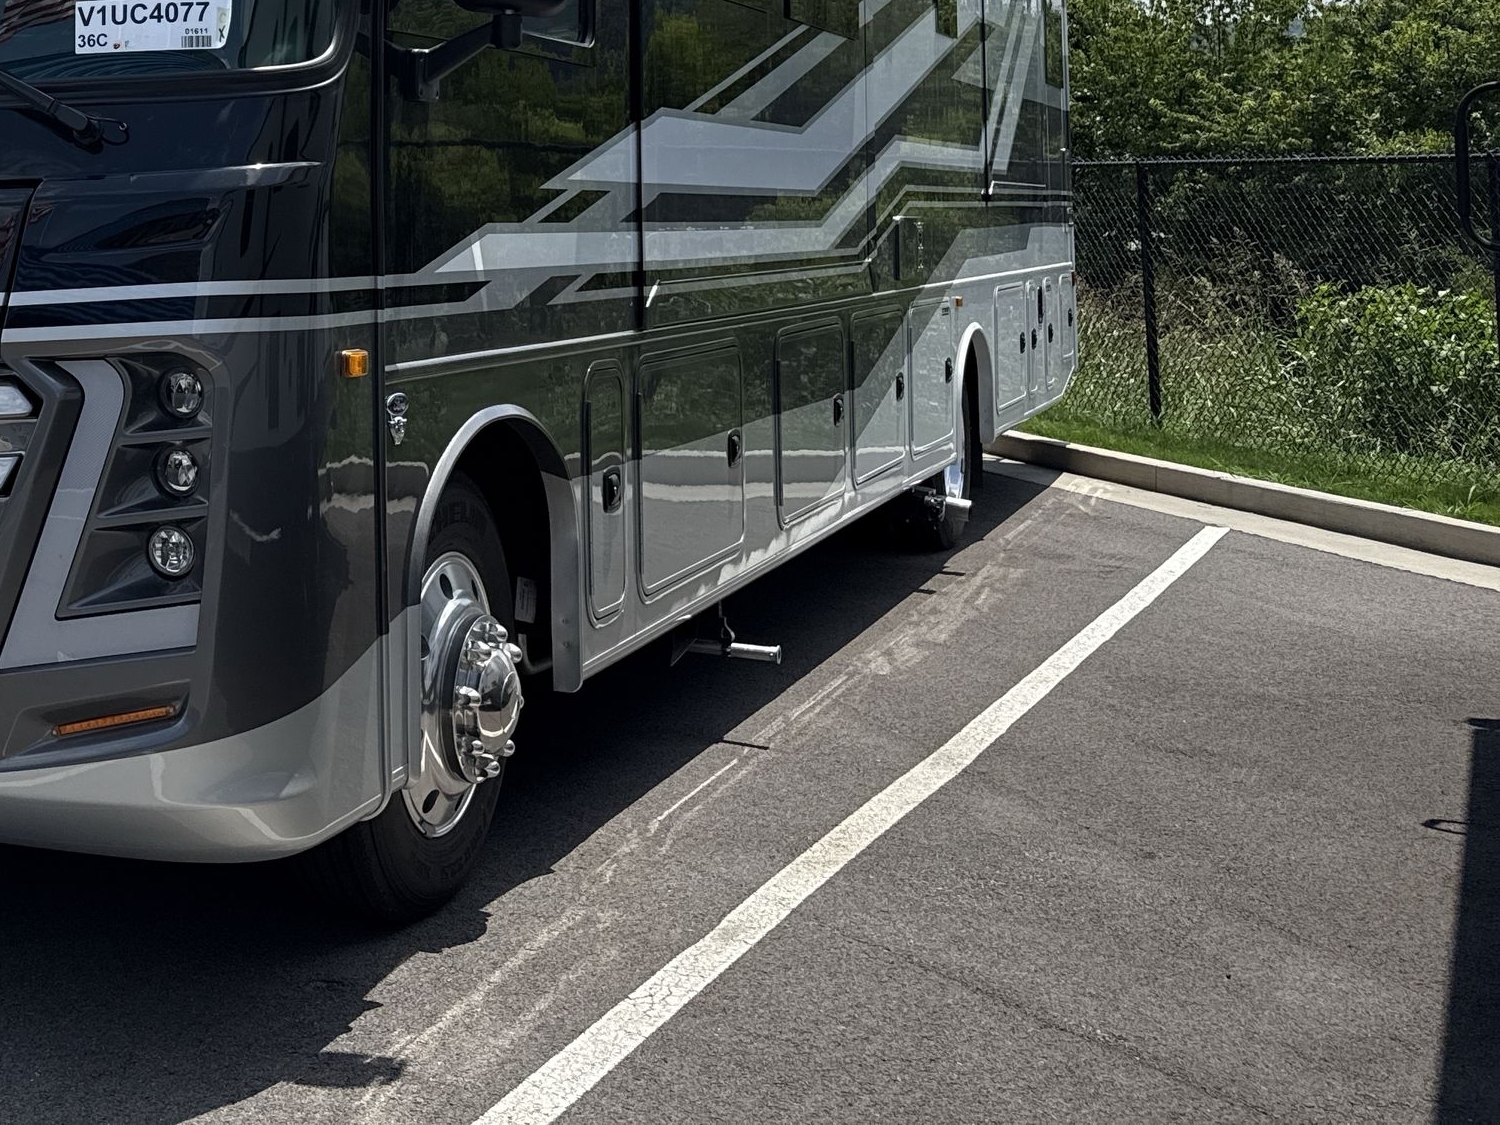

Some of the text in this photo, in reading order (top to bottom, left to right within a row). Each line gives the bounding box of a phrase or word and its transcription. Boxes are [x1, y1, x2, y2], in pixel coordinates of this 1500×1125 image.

[78, 1, 210, 27] V1UC4077
[185, 27, 208, 35] 01611
[77, 33, 108, 48] 36C
